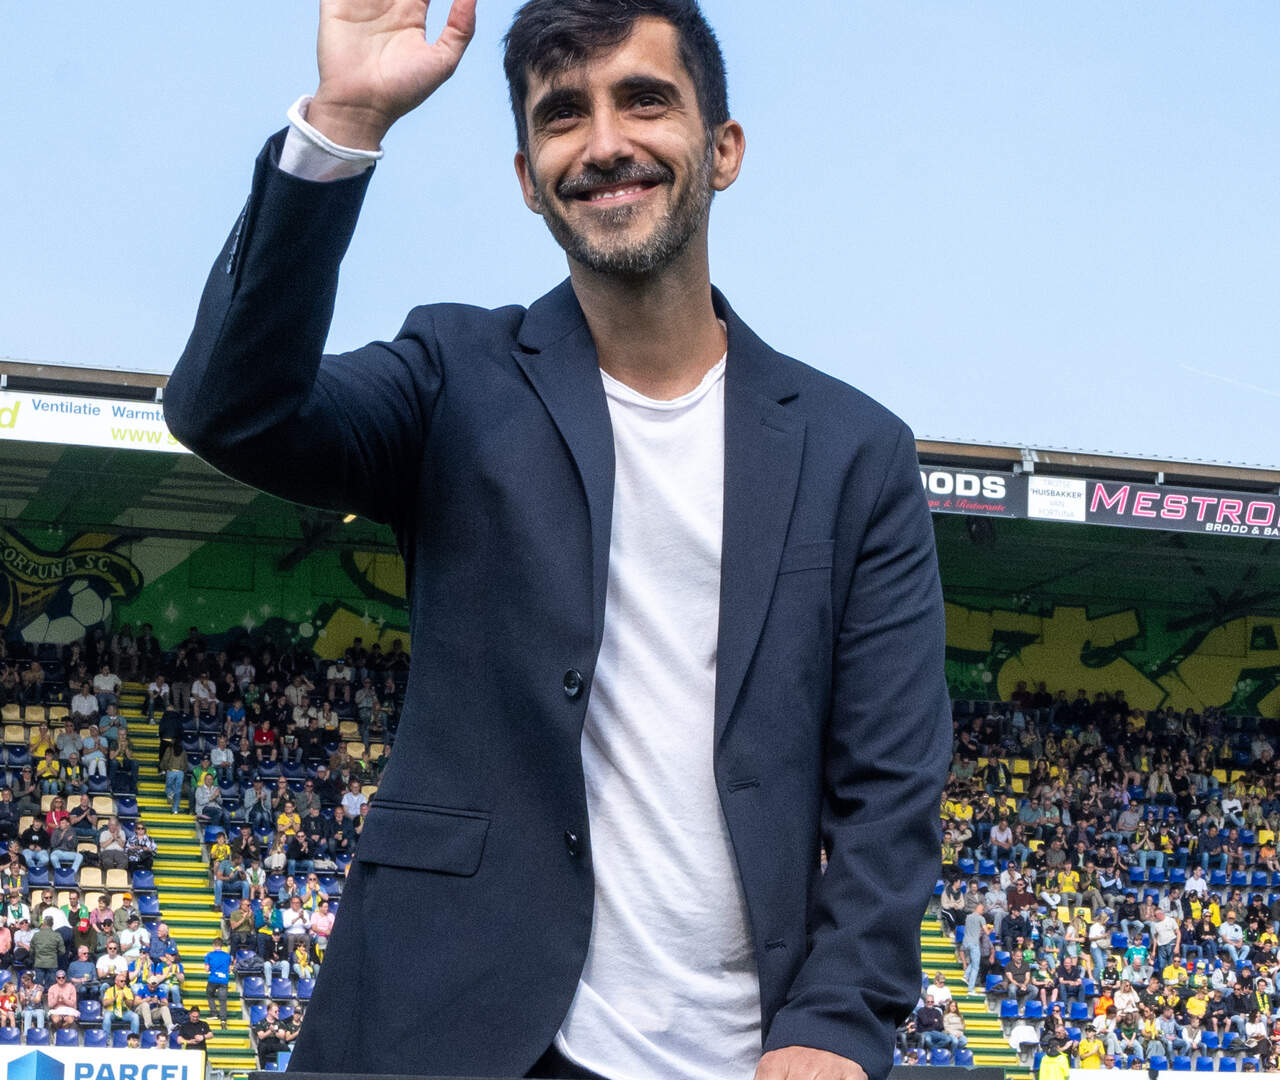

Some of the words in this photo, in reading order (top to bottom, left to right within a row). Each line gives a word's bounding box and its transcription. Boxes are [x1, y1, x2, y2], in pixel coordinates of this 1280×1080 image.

[31, 399, 101, 416] Ventilatie
[920, 471, 1006, 499] ODS
[1205, 522, 1249, 534] BROOD
[1251, 527, 1260, 536] &
[84, 554, 112, 572] SC
